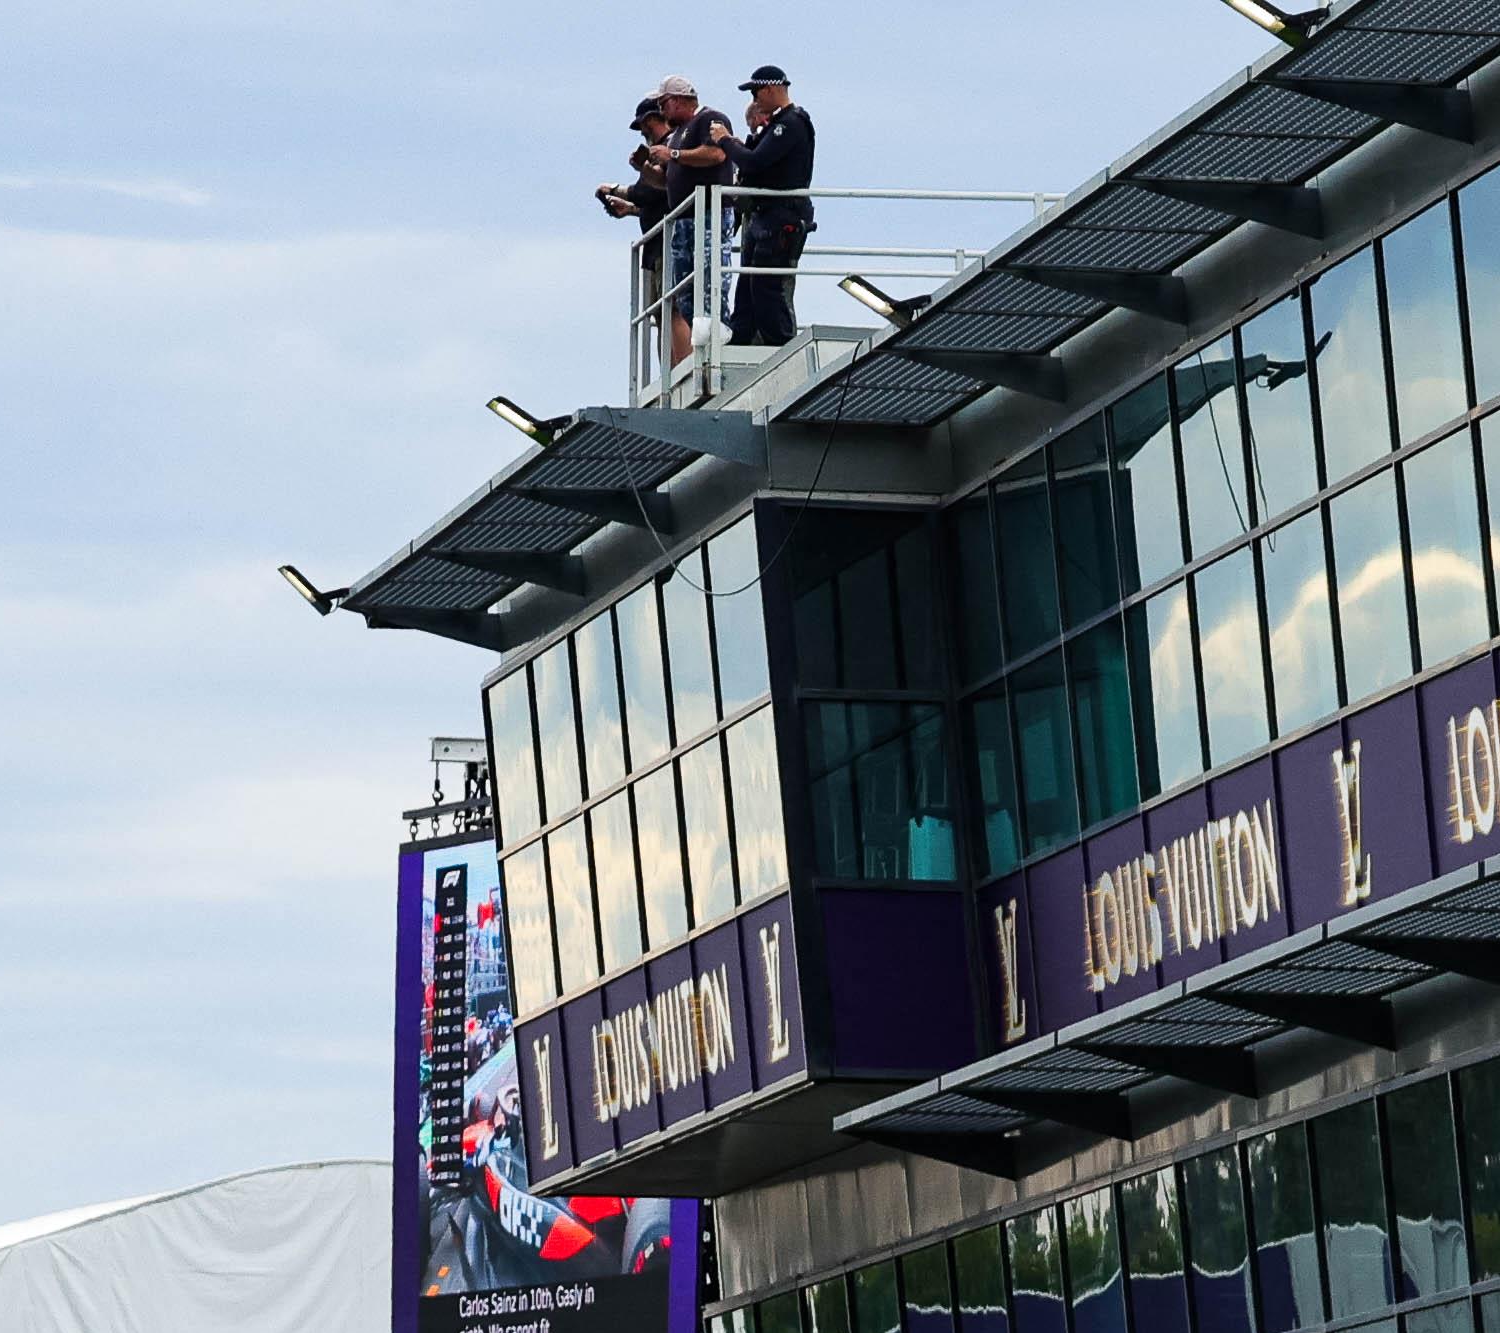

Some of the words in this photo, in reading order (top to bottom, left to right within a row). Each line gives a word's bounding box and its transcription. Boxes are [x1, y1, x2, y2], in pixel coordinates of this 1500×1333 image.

[1084, 850, 1159, 991] LOUIS
[1159, 799, 1281, 954] VUITTON
[593, 1003, 650, 1124] LOUIS
[650, 962, 735, 1094] VUITTON
[459, 1294, 489, 1317] Carlos
[491, 1292, 516, 1314] Sainz
[519, 1289, 528, 1311] in
[530, 1287, 554, 1311] 10th,
[556, 1283, 582, 1311] Gasly
[584, 1282, 595, 1304] in
